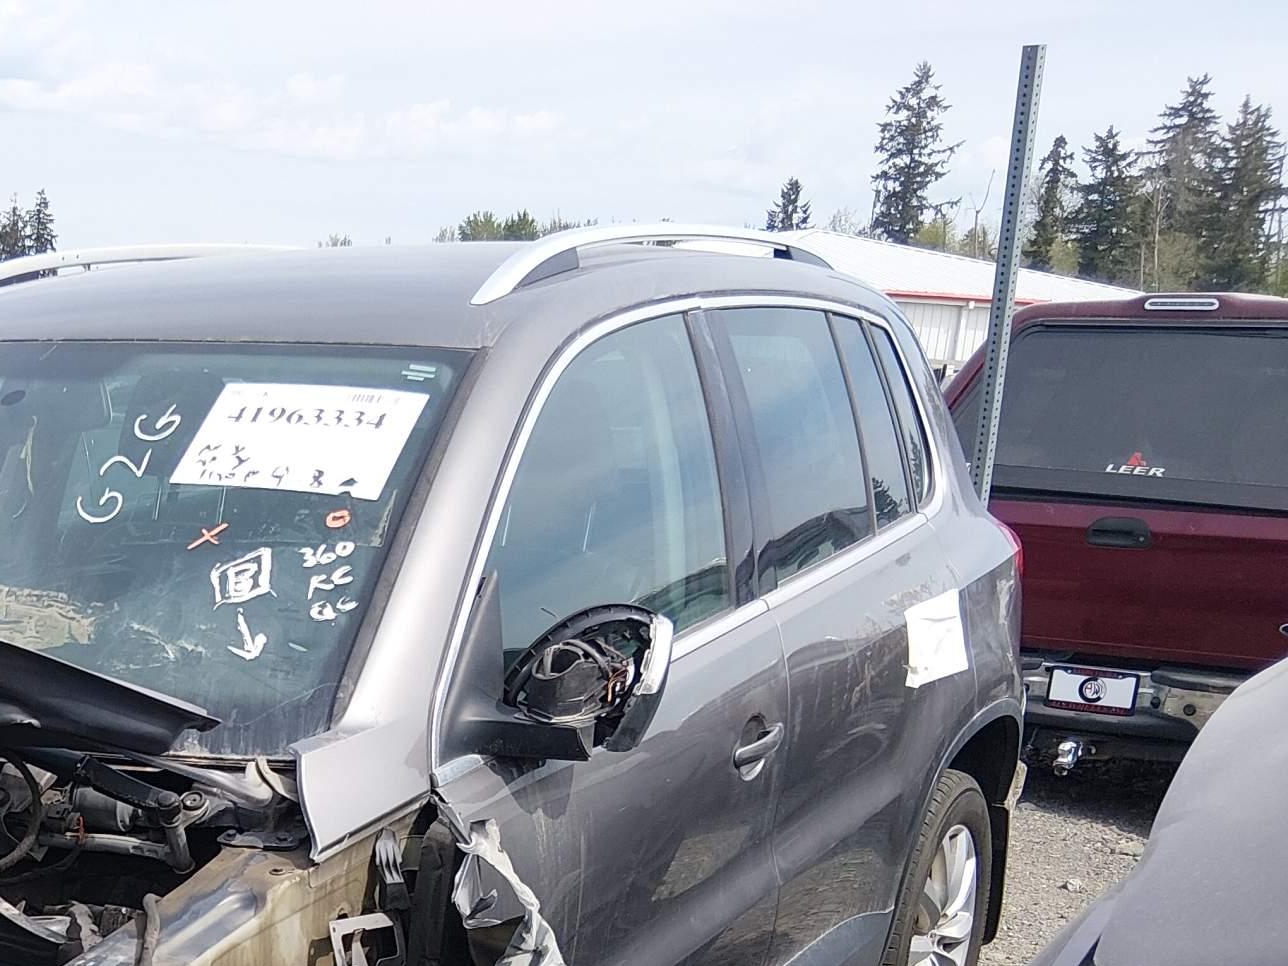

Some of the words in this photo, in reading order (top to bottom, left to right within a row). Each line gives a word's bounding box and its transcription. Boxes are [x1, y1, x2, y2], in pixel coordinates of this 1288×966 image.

[228, 406, 387, 430] 41963334
[1105, 463, 1166, 477] LEER
[297, 541, 356, 568] 360
